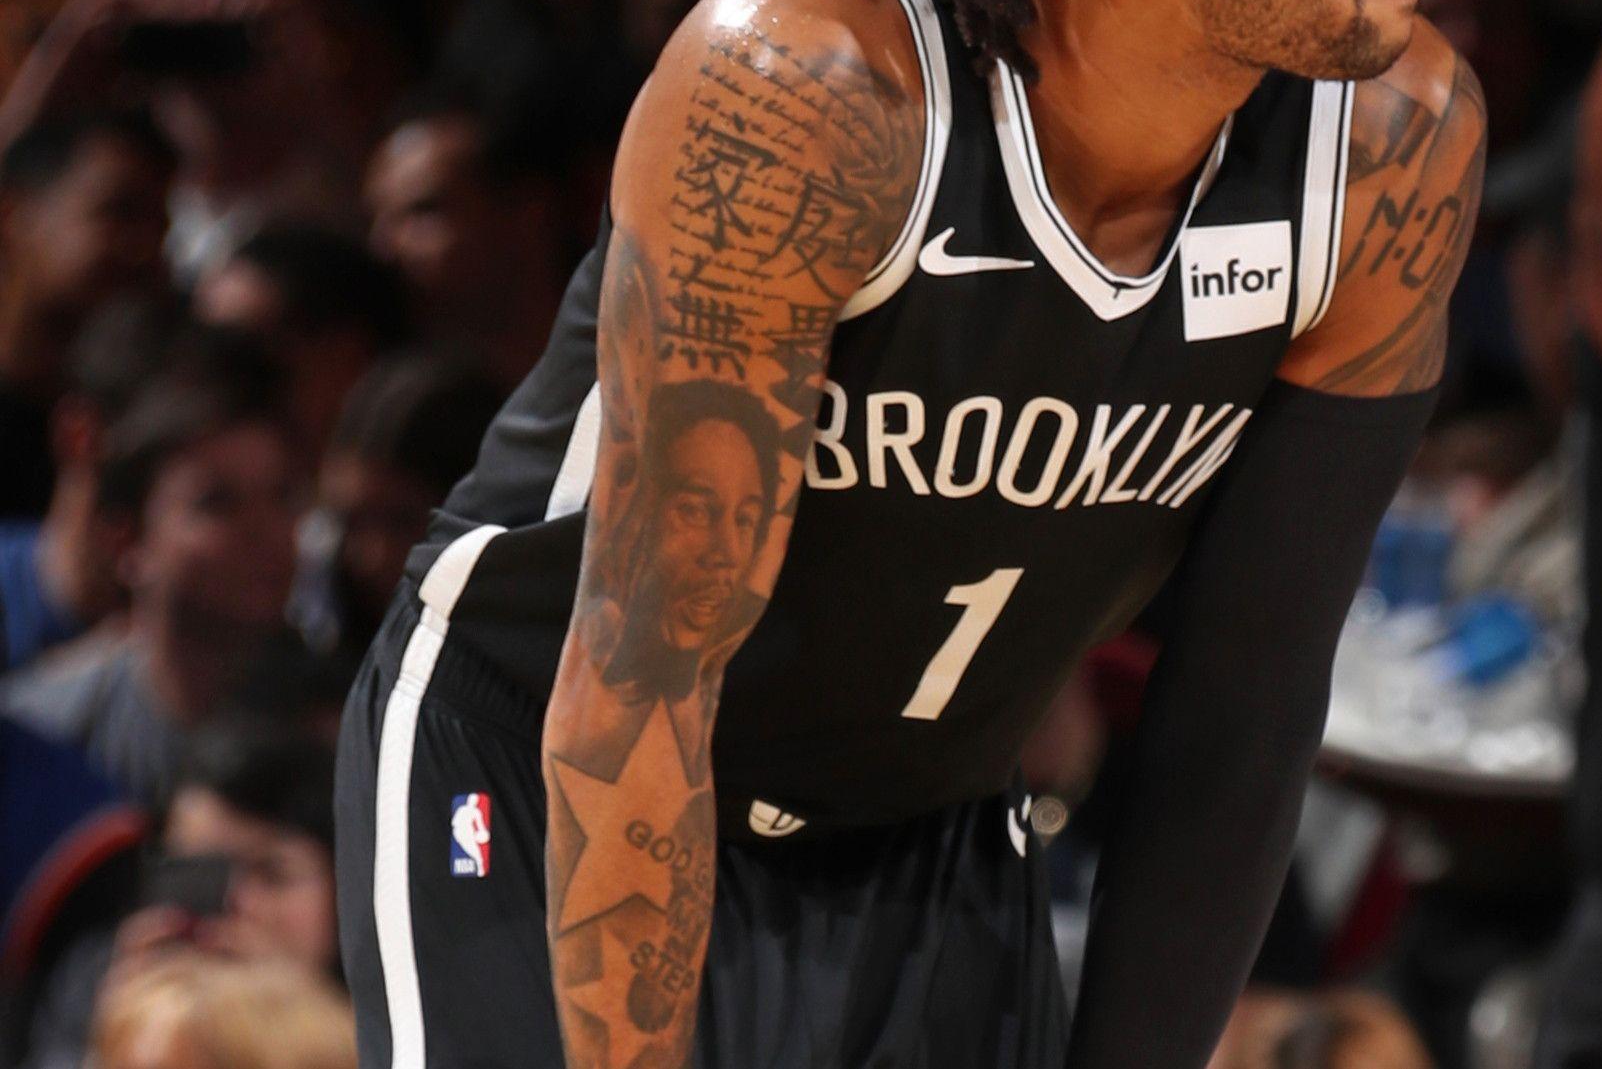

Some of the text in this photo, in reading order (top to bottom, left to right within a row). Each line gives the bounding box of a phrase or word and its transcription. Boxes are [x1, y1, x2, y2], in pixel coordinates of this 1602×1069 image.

[1190, 257, 1283, 298] infor
[803, 379, 1253, 511] BROOKLYN
[900, 566, 1025, 721] 1
[625, 819, 692, 873] GOD
